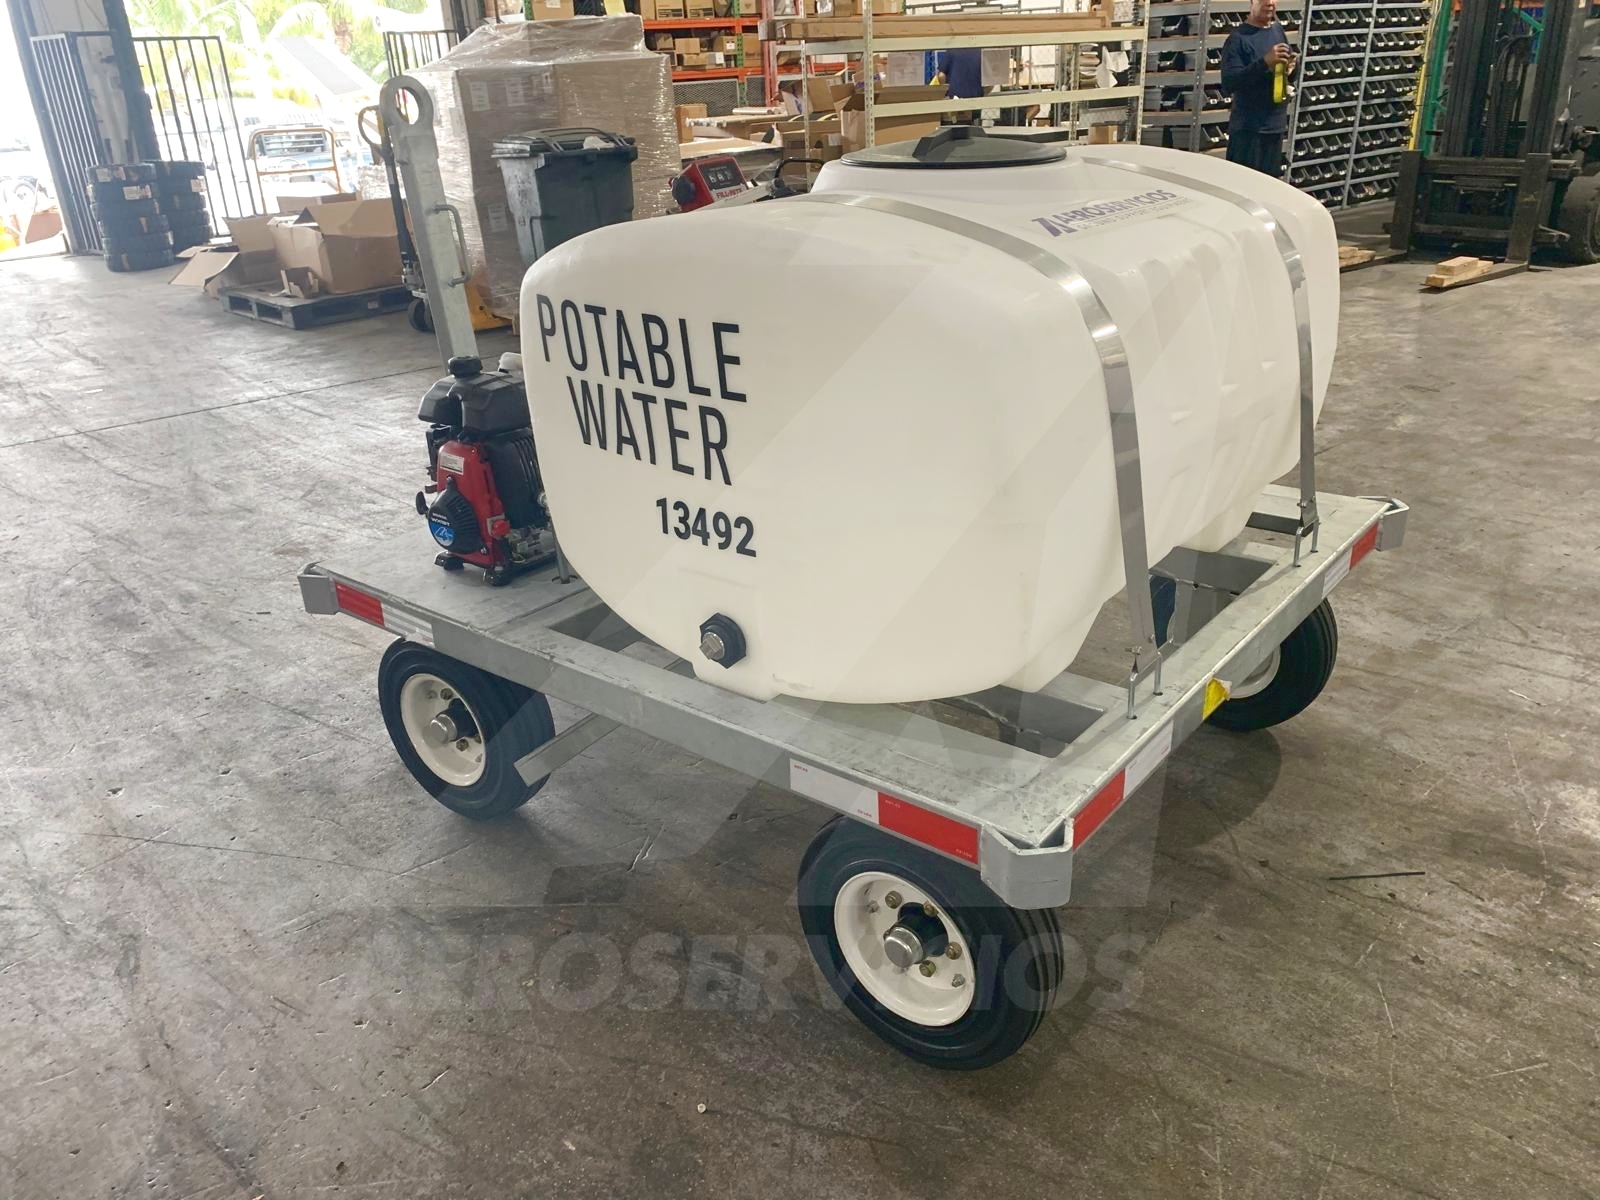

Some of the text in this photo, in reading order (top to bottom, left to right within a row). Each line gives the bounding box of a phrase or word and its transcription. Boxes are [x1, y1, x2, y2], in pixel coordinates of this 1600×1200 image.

[536, 293, 747, 402] POTABLE
[566, 376, 732, 486] WATER
[656, 497, 756, 557] 13492
